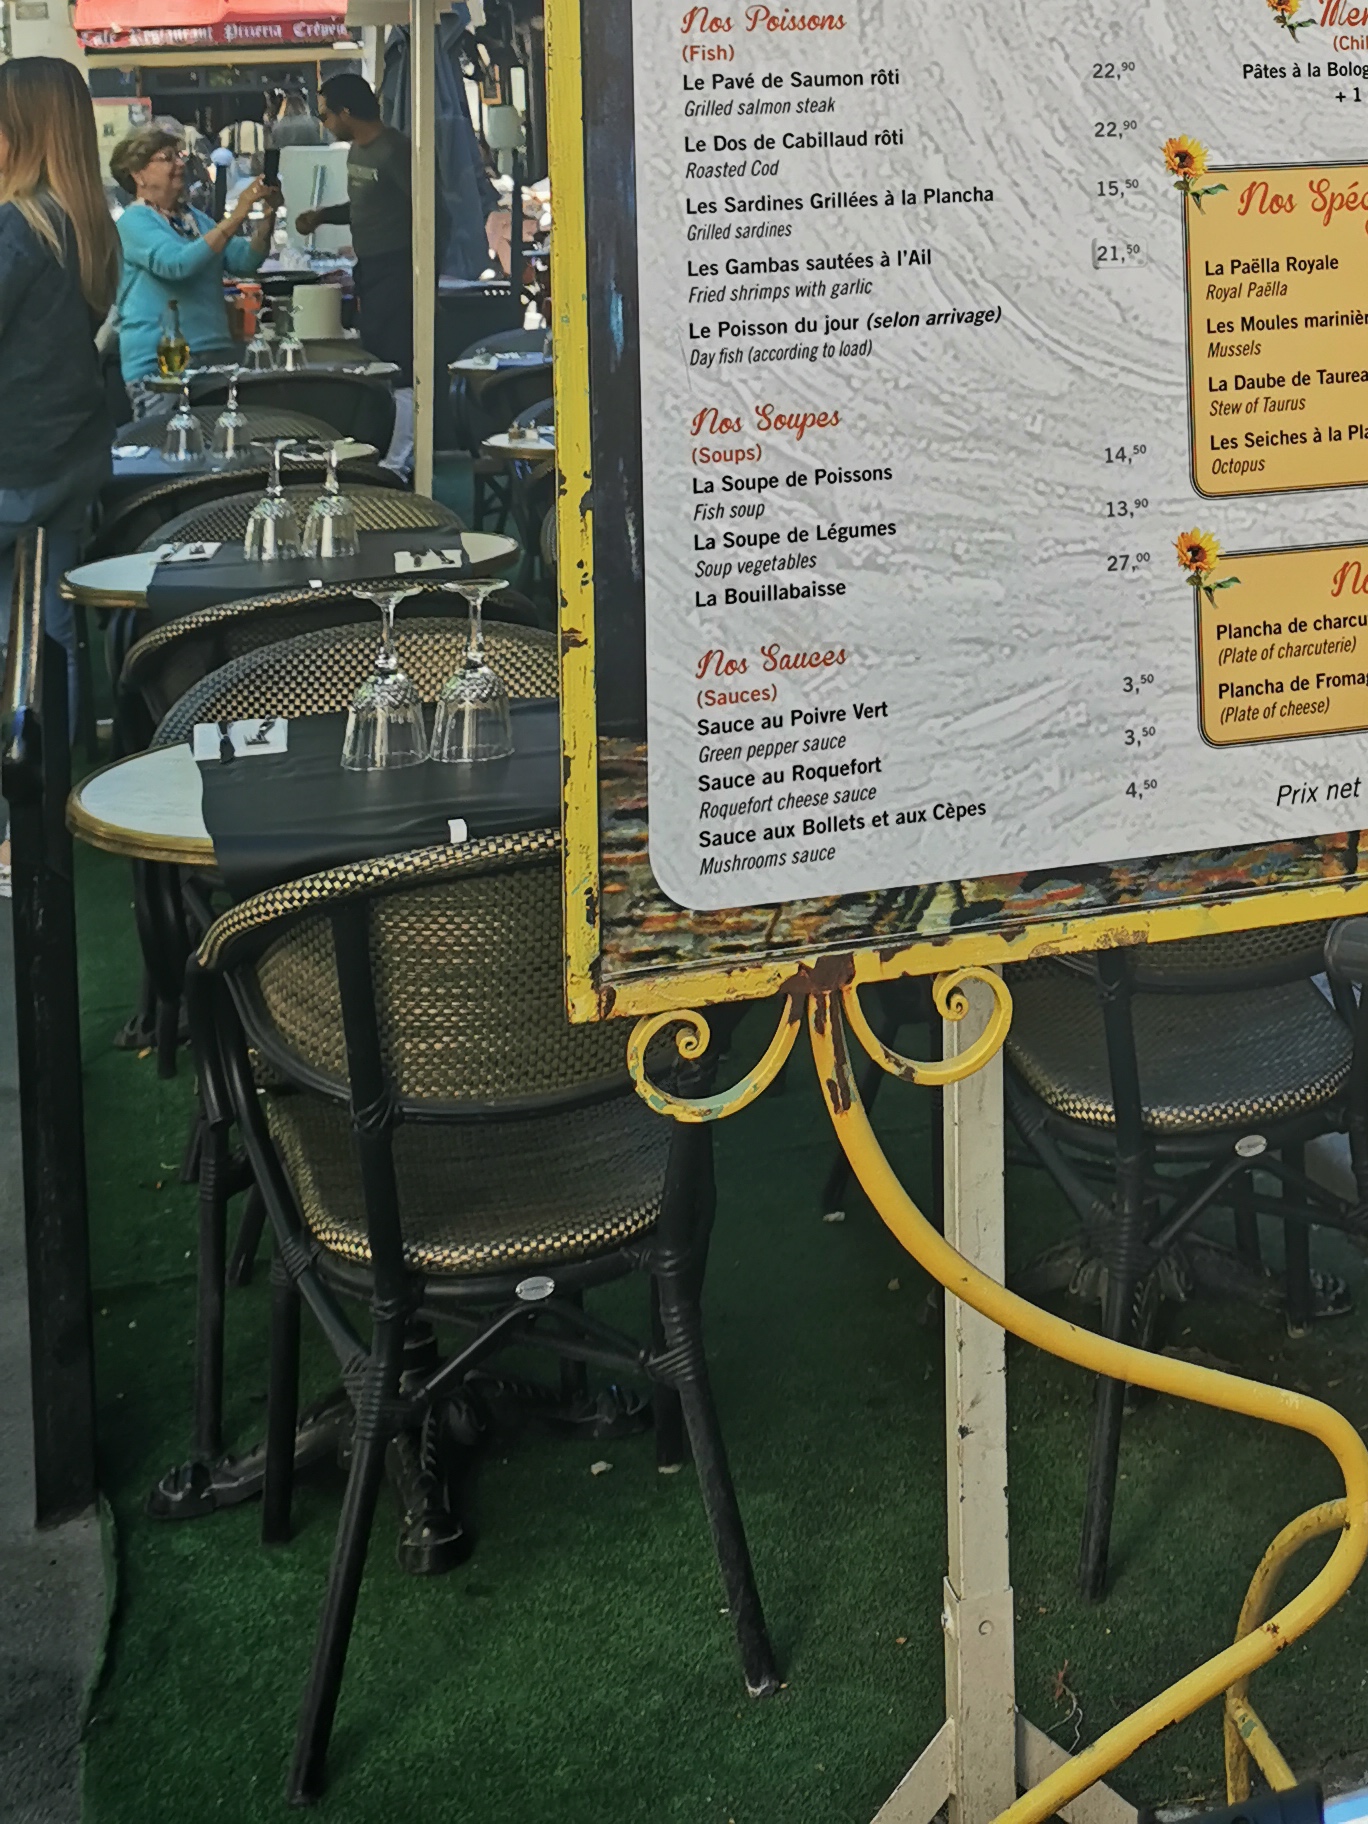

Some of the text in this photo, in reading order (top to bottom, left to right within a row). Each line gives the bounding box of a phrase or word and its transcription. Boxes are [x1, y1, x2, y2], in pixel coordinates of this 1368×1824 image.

[679, 3, 846, 34] Nos Poissons
[681, 43, 735, 63] (Fish)
[685, 185, 994, 215] Les Sardines Grillées à la Plancha
[1236, 180, 1295, 217] Nos
[1203, 253, 1339, 276] La Paëlla Royale
[1206, 338, 1262, 358] Mussels
[689, 402, 842, 441] Nos Soupes
[690, 442, 762, 466] (Soups)
[694, 641, 847, 680] Nos Sauces
[696, 682, 777, 709] (Sauces)
[1217, 677, 1285, 700] Plancha
[1289, 674, 1310, 692] de
[696, 755, 883, 793] Sauce au Roquefort
[1275, 781, 1319, 807] Prix
[1325, 775, 1362, 801] net
[698, 845, 836, 876] Mushrooms sauce
